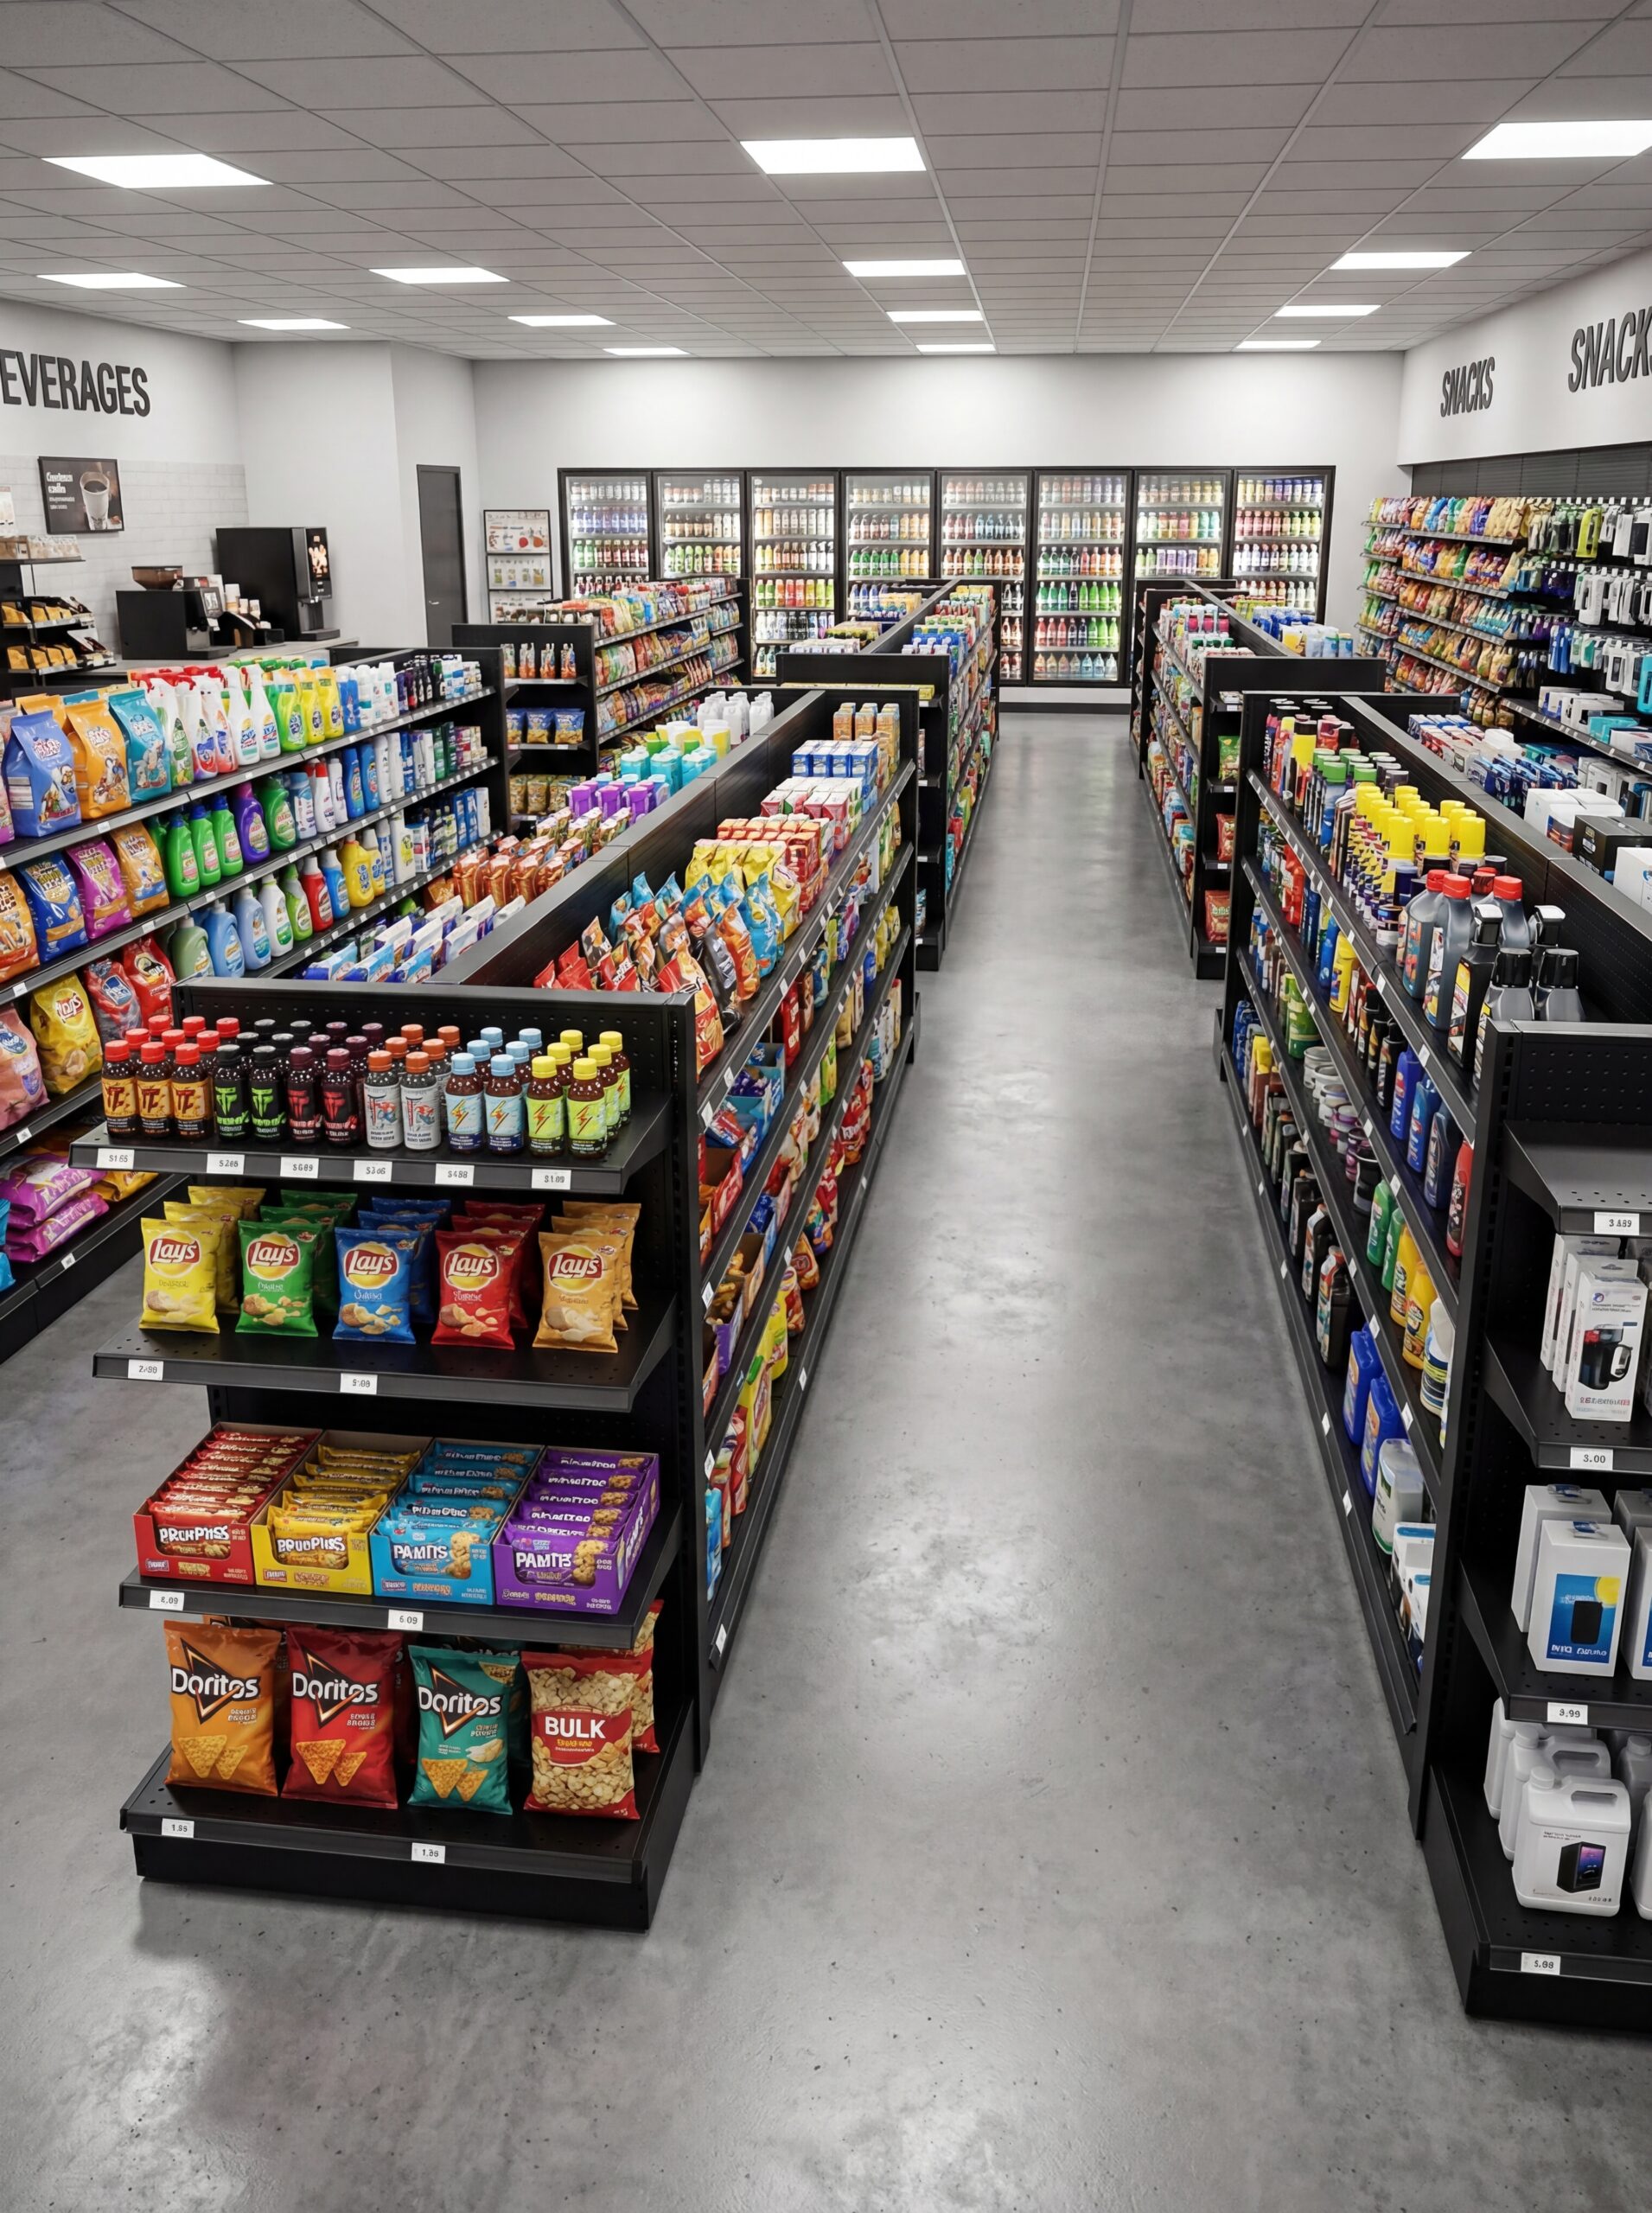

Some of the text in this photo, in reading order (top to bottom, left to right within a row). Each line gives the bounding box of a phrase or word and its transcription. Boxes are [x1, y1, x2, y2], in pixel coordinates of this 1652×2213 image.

[1568, 306, 1652, 392] SNACK
[1440, 356, 1496, 418] SNACKS
[172, 1668, 258, 1699] Doritos
[292, 1672, 379, 1703] Doritos
[418, 1686, 501, 1715] Doritos
[545, 1716, 606, 1739] BULK
